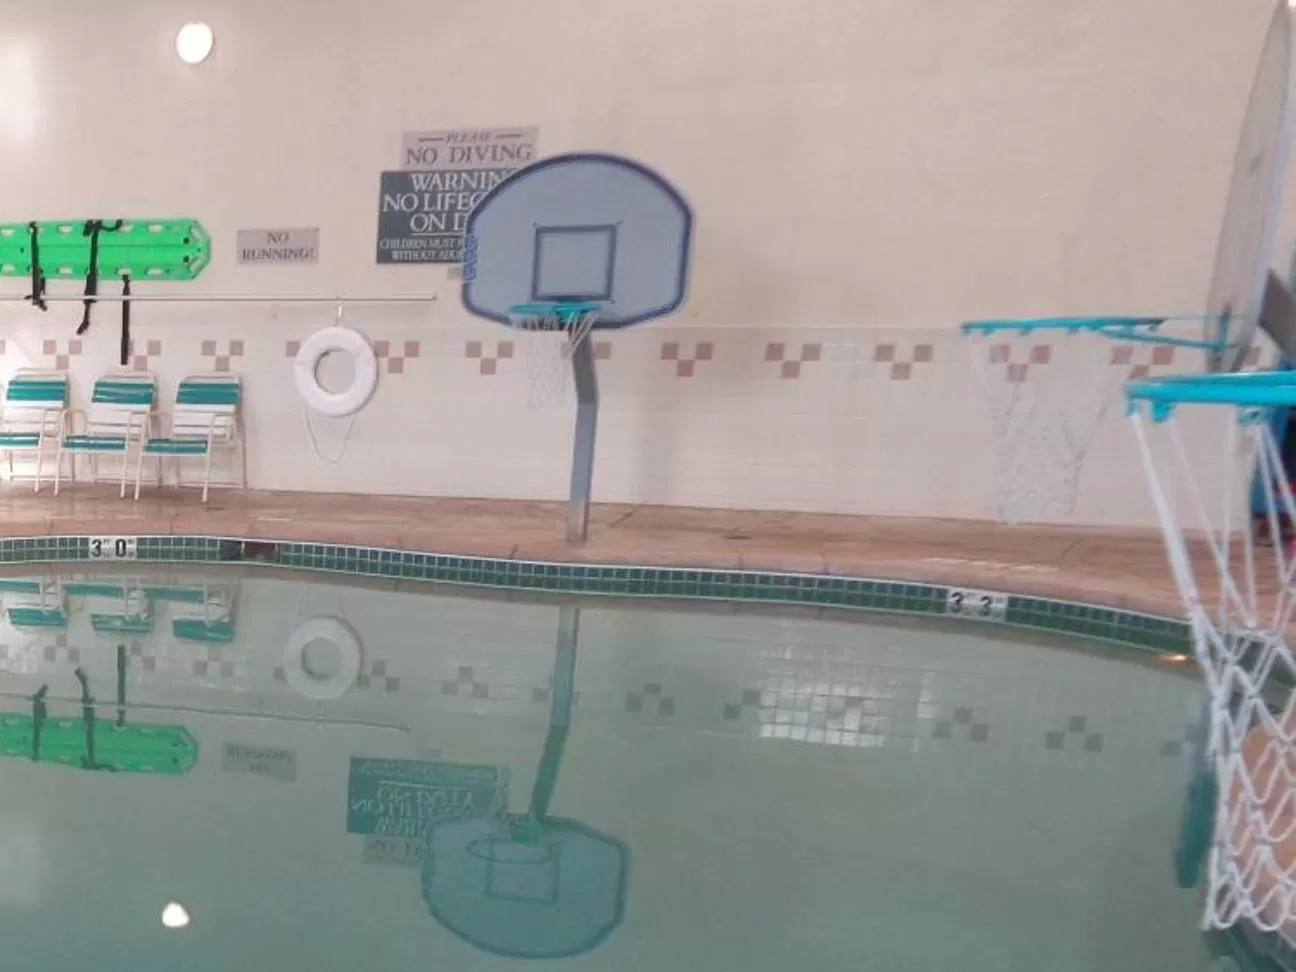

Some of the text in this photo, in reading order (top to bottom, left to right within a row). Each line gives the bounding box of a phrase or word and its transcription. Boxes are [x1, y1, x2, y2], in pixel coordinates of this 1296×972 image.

[405, 143, 533, 165] NO DIVING
[411, 170, 508, 193] WARNIN
[382, 192, 420, 212] NO
[409, 211, 447, 233] ON
[266, 231, 291, 244] NO
